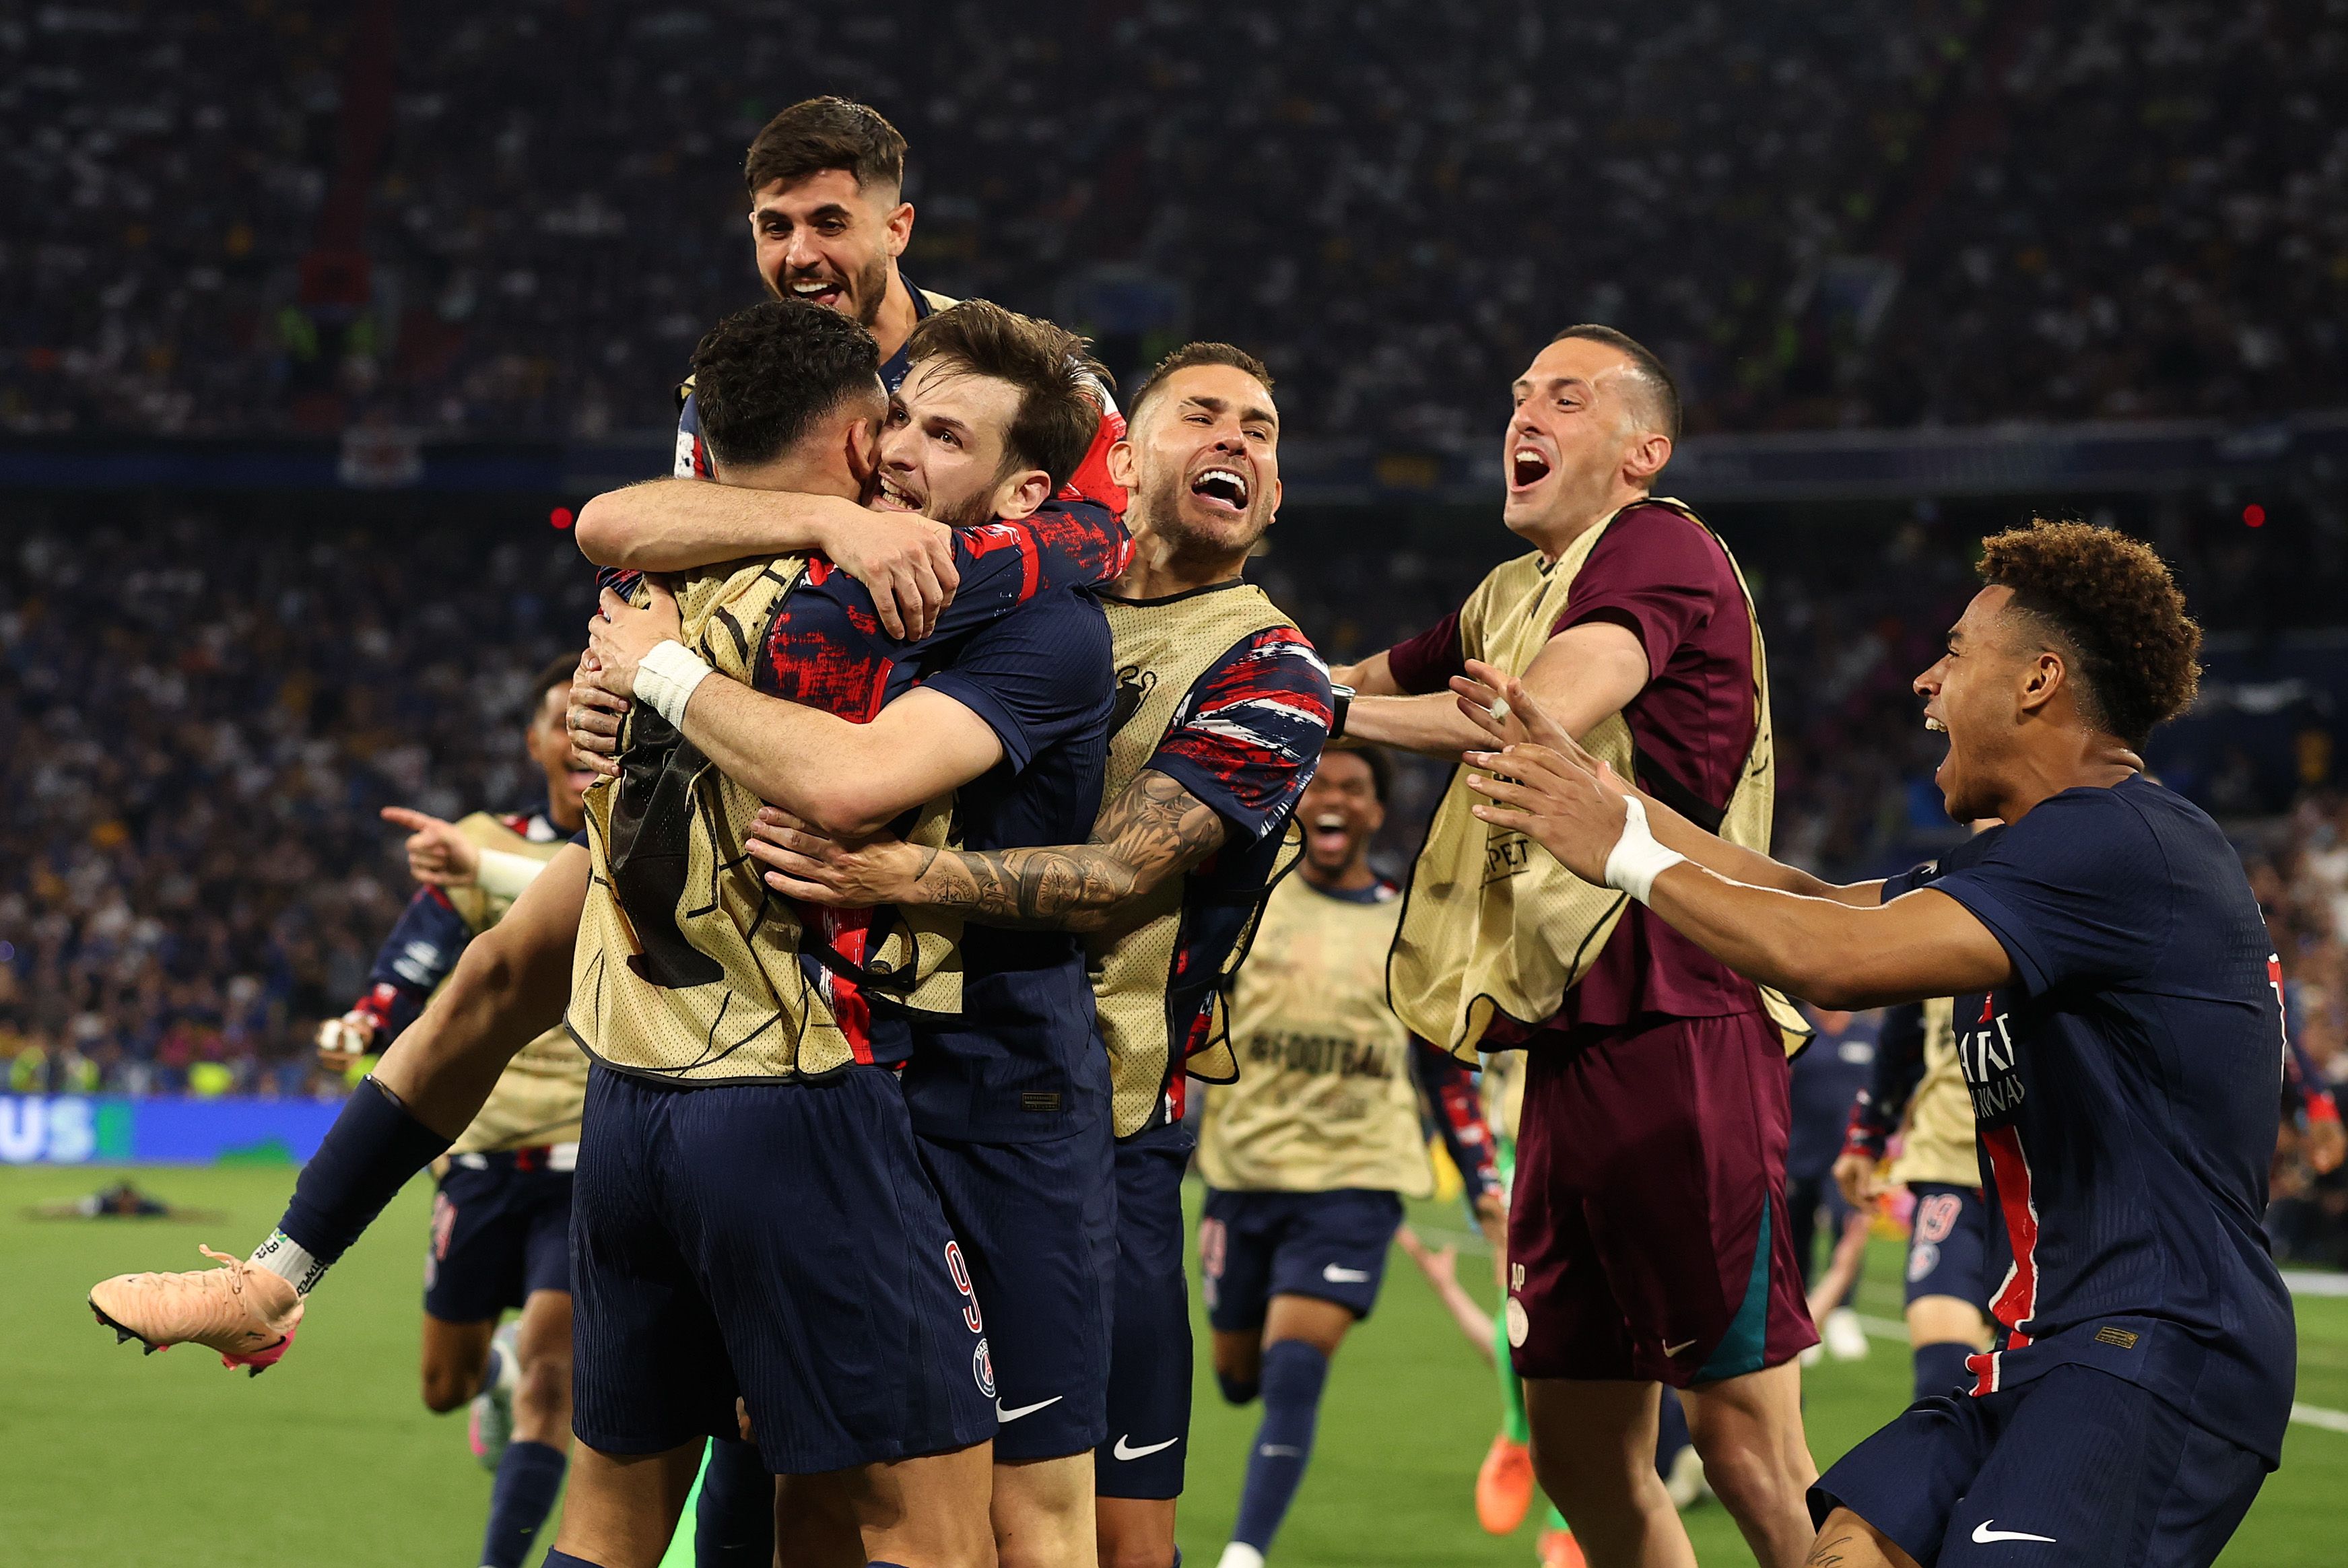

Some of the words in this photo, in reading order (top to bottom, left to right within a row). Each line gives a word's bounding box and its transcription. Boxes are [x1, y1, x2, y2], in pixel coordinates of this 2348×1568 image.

[1912, 1193, 1963, 1246] 19
[945, 1240, 982, 1334] 9
[1511, 1262, 1526, 1293] AP
